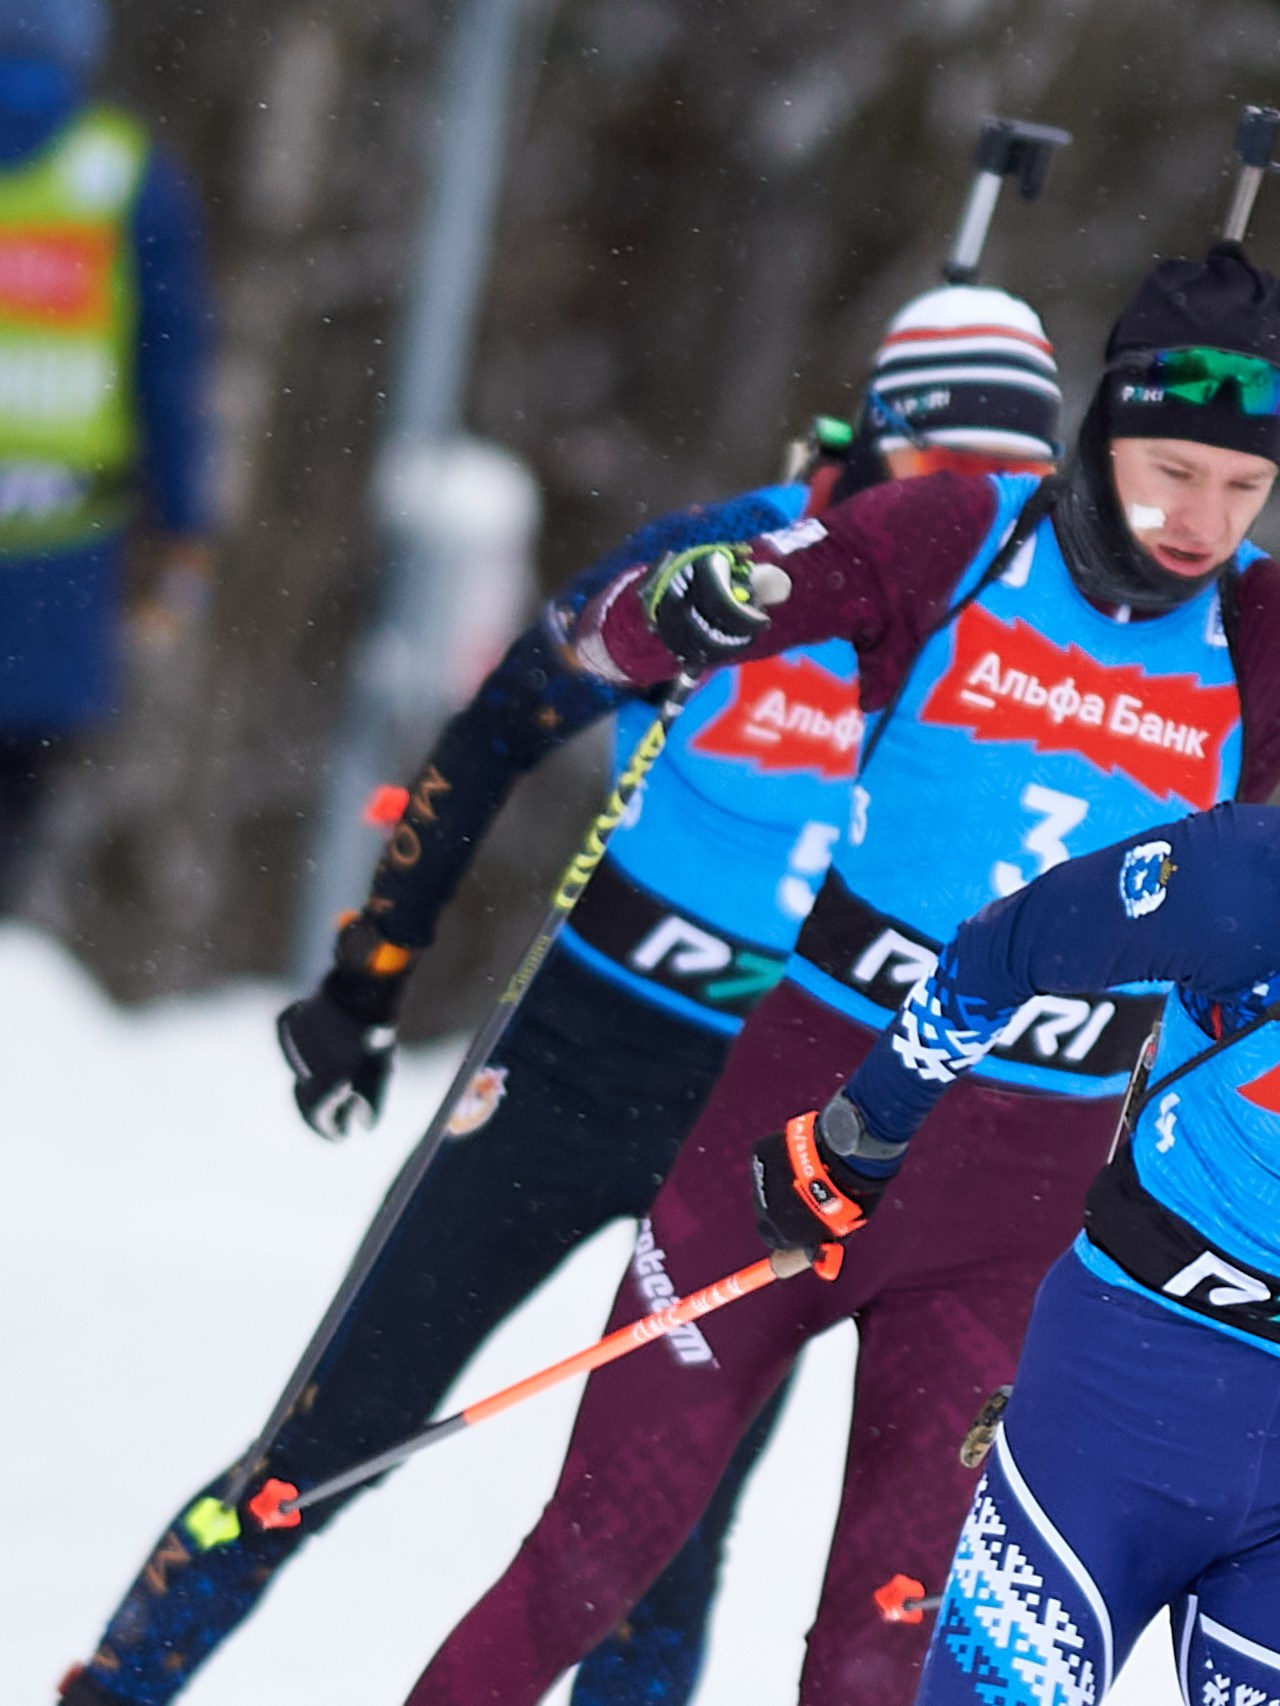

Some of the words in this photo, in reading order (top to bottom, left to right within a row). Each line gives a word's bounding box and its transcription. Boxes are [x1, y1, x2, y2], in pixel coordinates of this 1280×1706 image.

[752, 688, 865, 751] Альф
[966, 651, 1106, 723] Альфа
[1109, 694, 1210, 758] Банк
[995, 783, 1090, 897] 3
[853, 928, 1116, 1061] PRI
